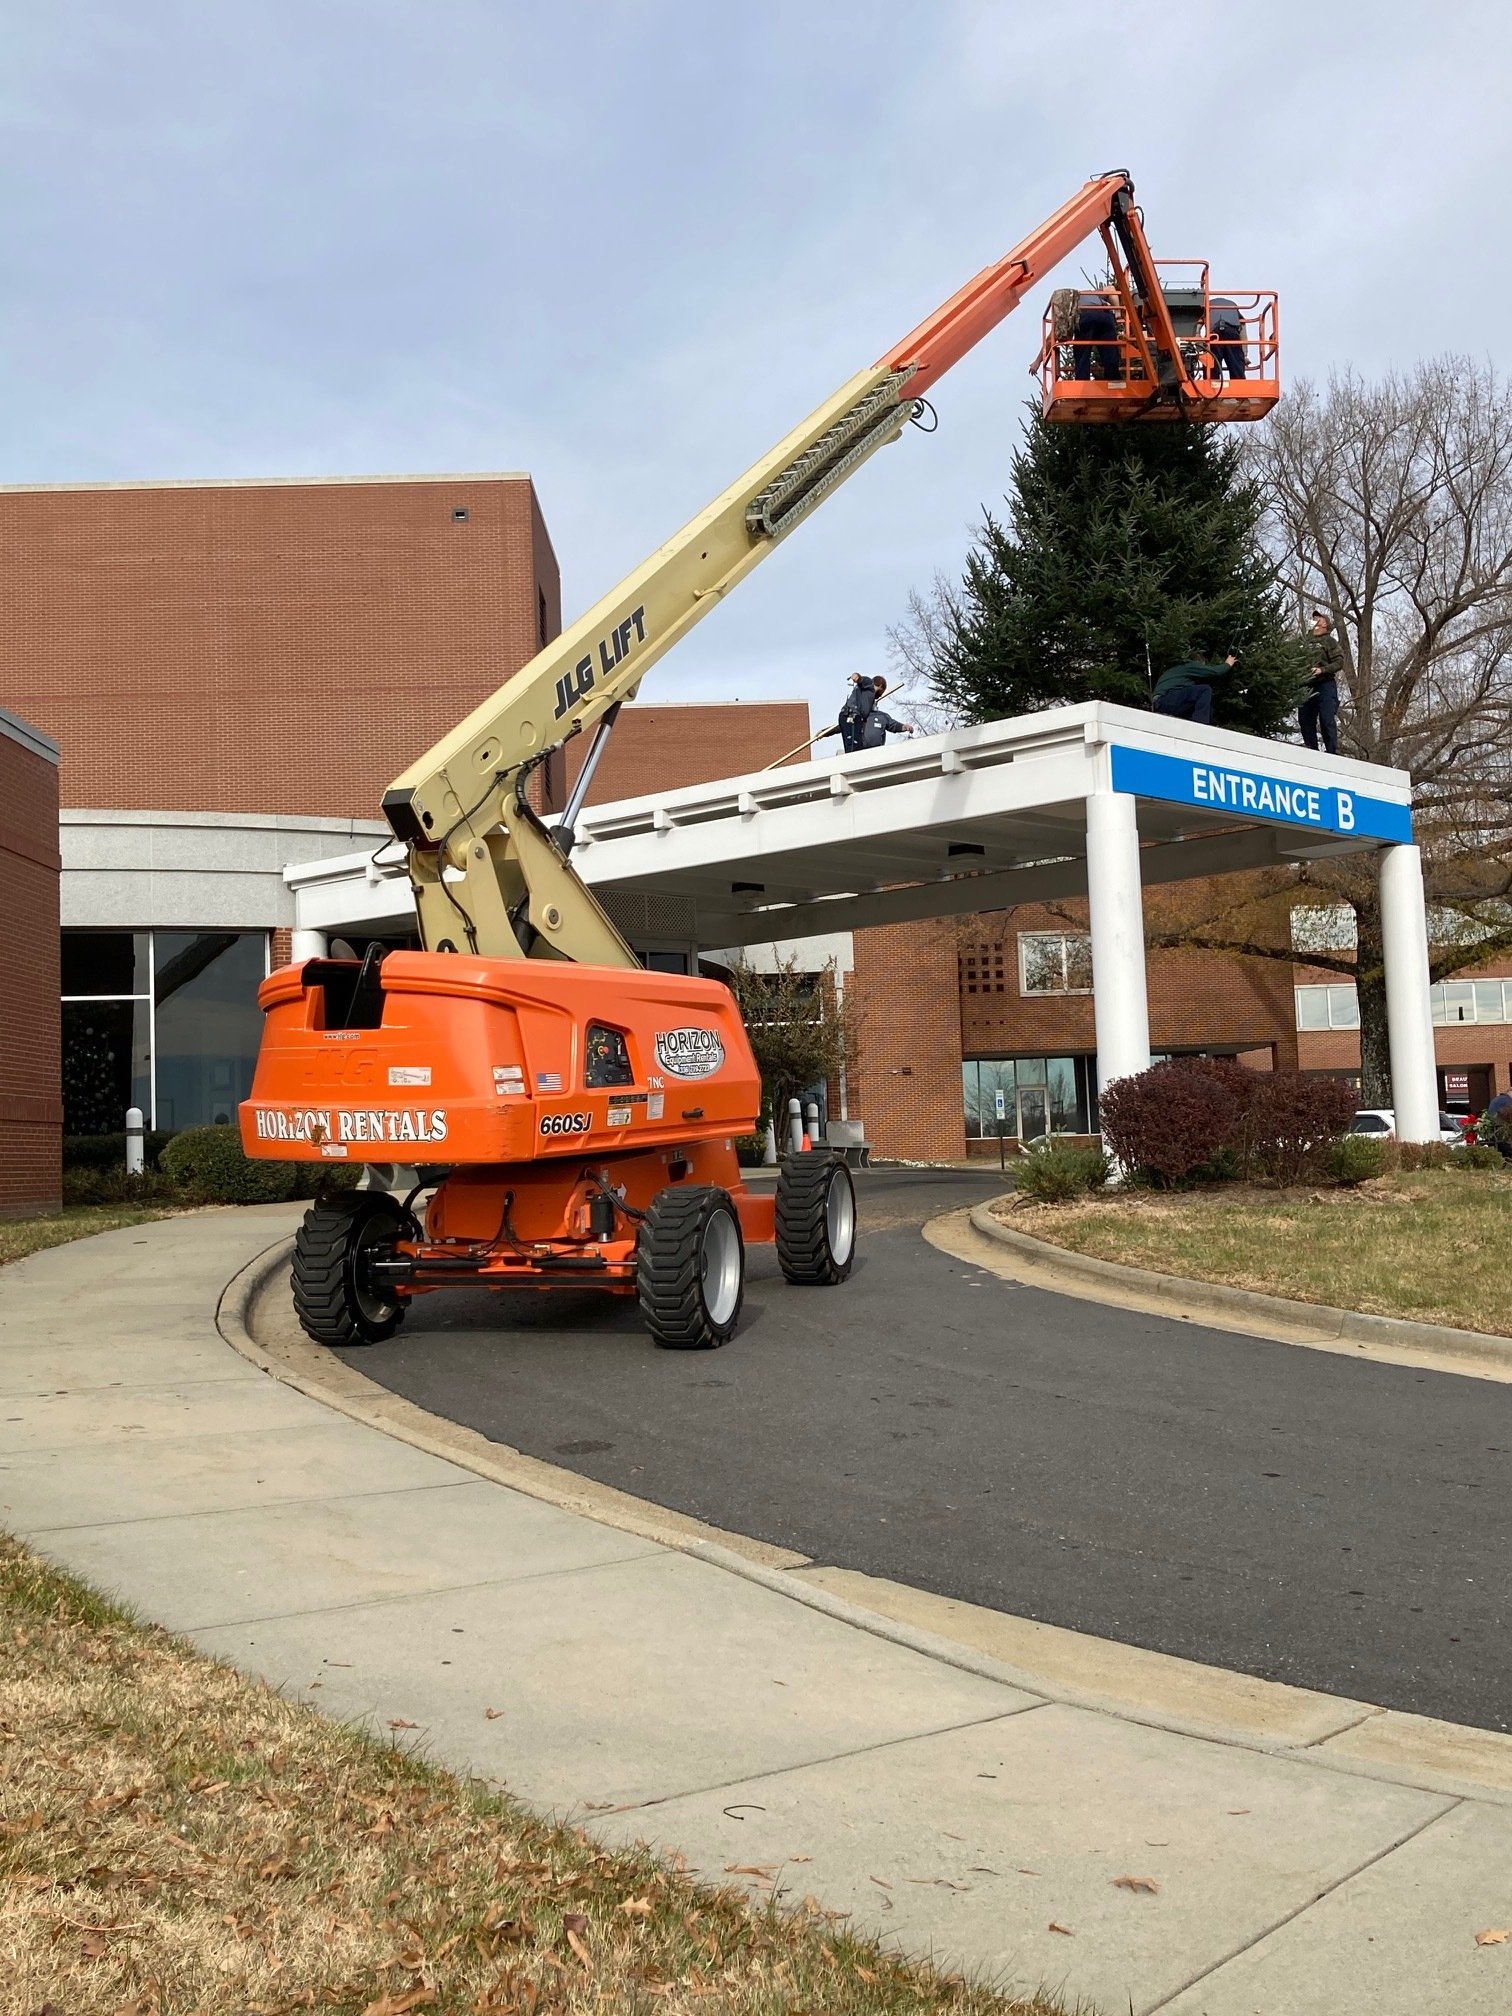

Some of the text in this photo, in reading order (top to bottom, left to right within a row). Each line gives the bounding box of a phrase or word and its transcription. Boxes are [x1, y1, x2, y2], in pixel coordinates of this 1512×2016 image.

[554, 604, 645, 720] JLG LIFT
[1193, 767, 1355, 830] ENTRANCE B
[655, 1030, 721, 1053] HORIZON
[665, 1051, 718, 1066] Equipment Rentals
[338, 1109, 448, 1141] RENTALS
[540, 1113, 593, 1135] 660SJ
